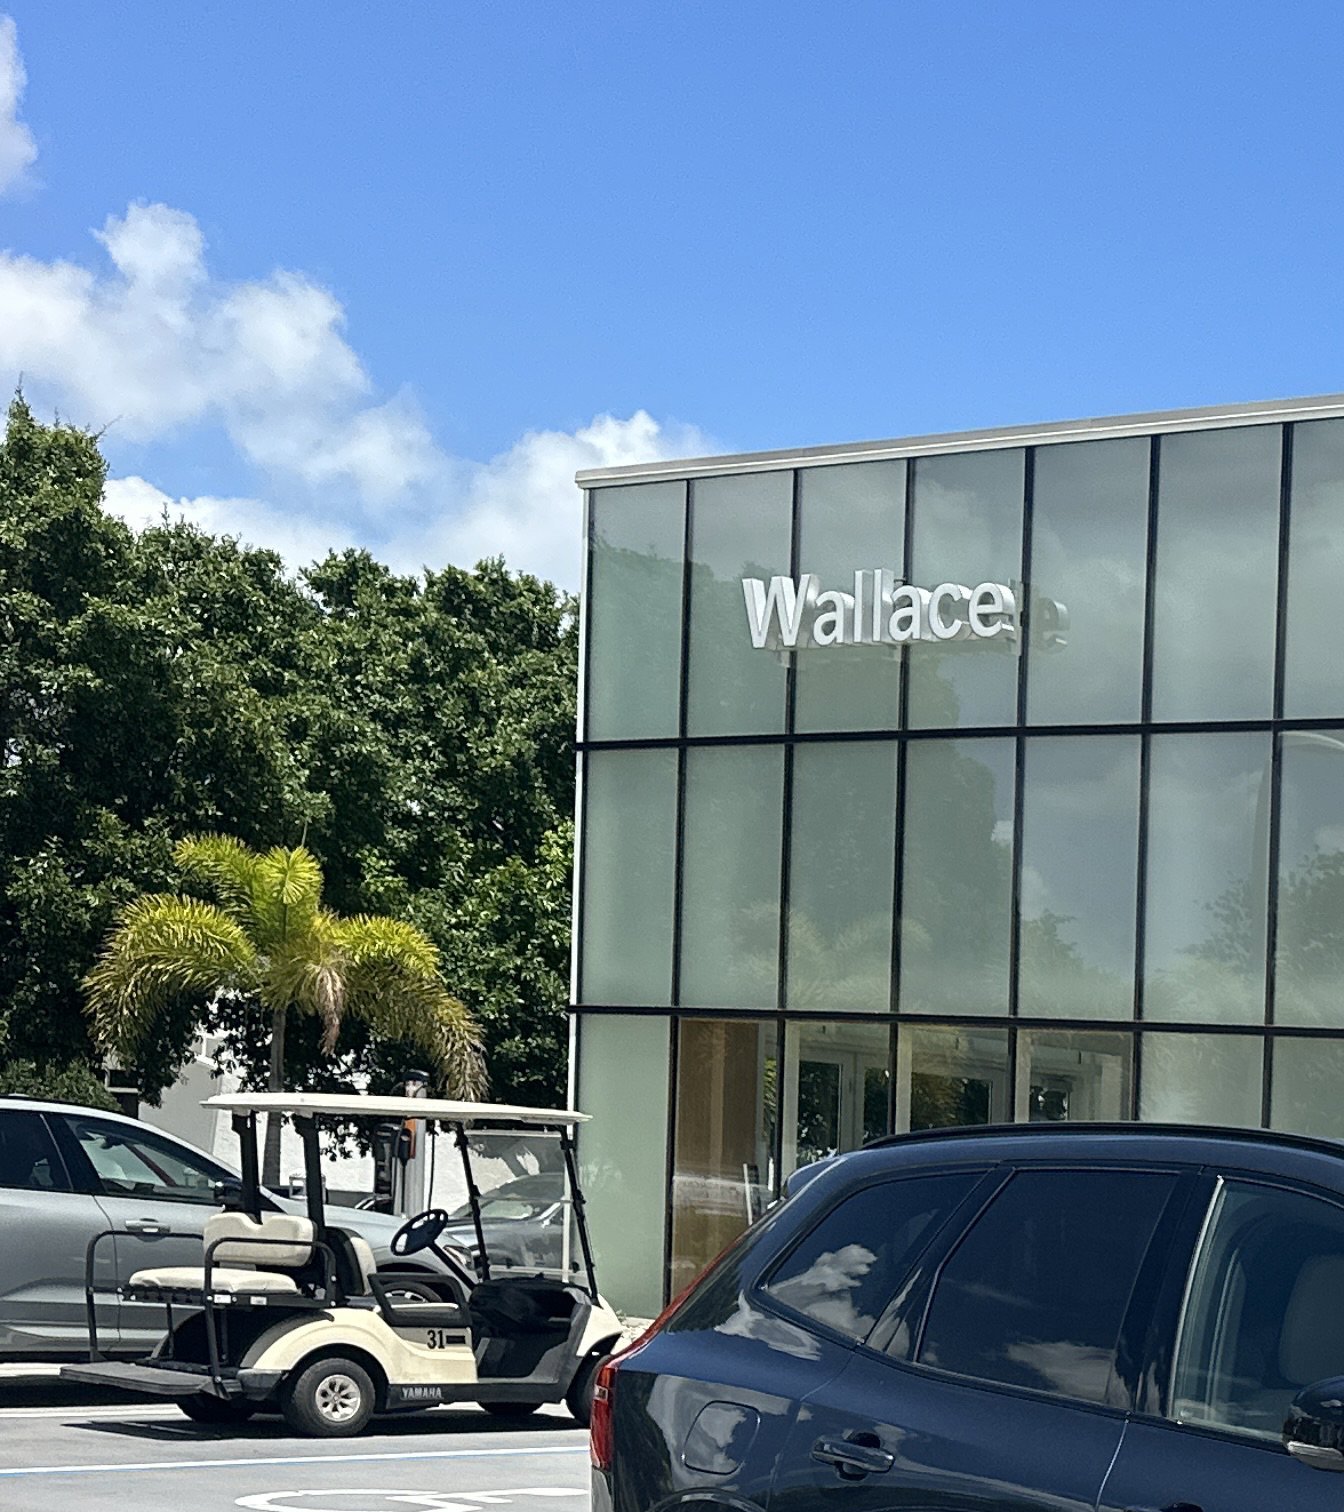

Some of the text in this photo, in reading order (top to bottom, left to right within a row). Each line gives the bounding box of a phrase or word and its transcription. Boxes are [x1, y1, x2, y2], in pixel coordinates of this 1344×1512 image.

[742, 568, 1012, 649] Wallace
[427, 1329, 445, 1349] 31
[402, 1386, 443, 1399] YAMAHA
